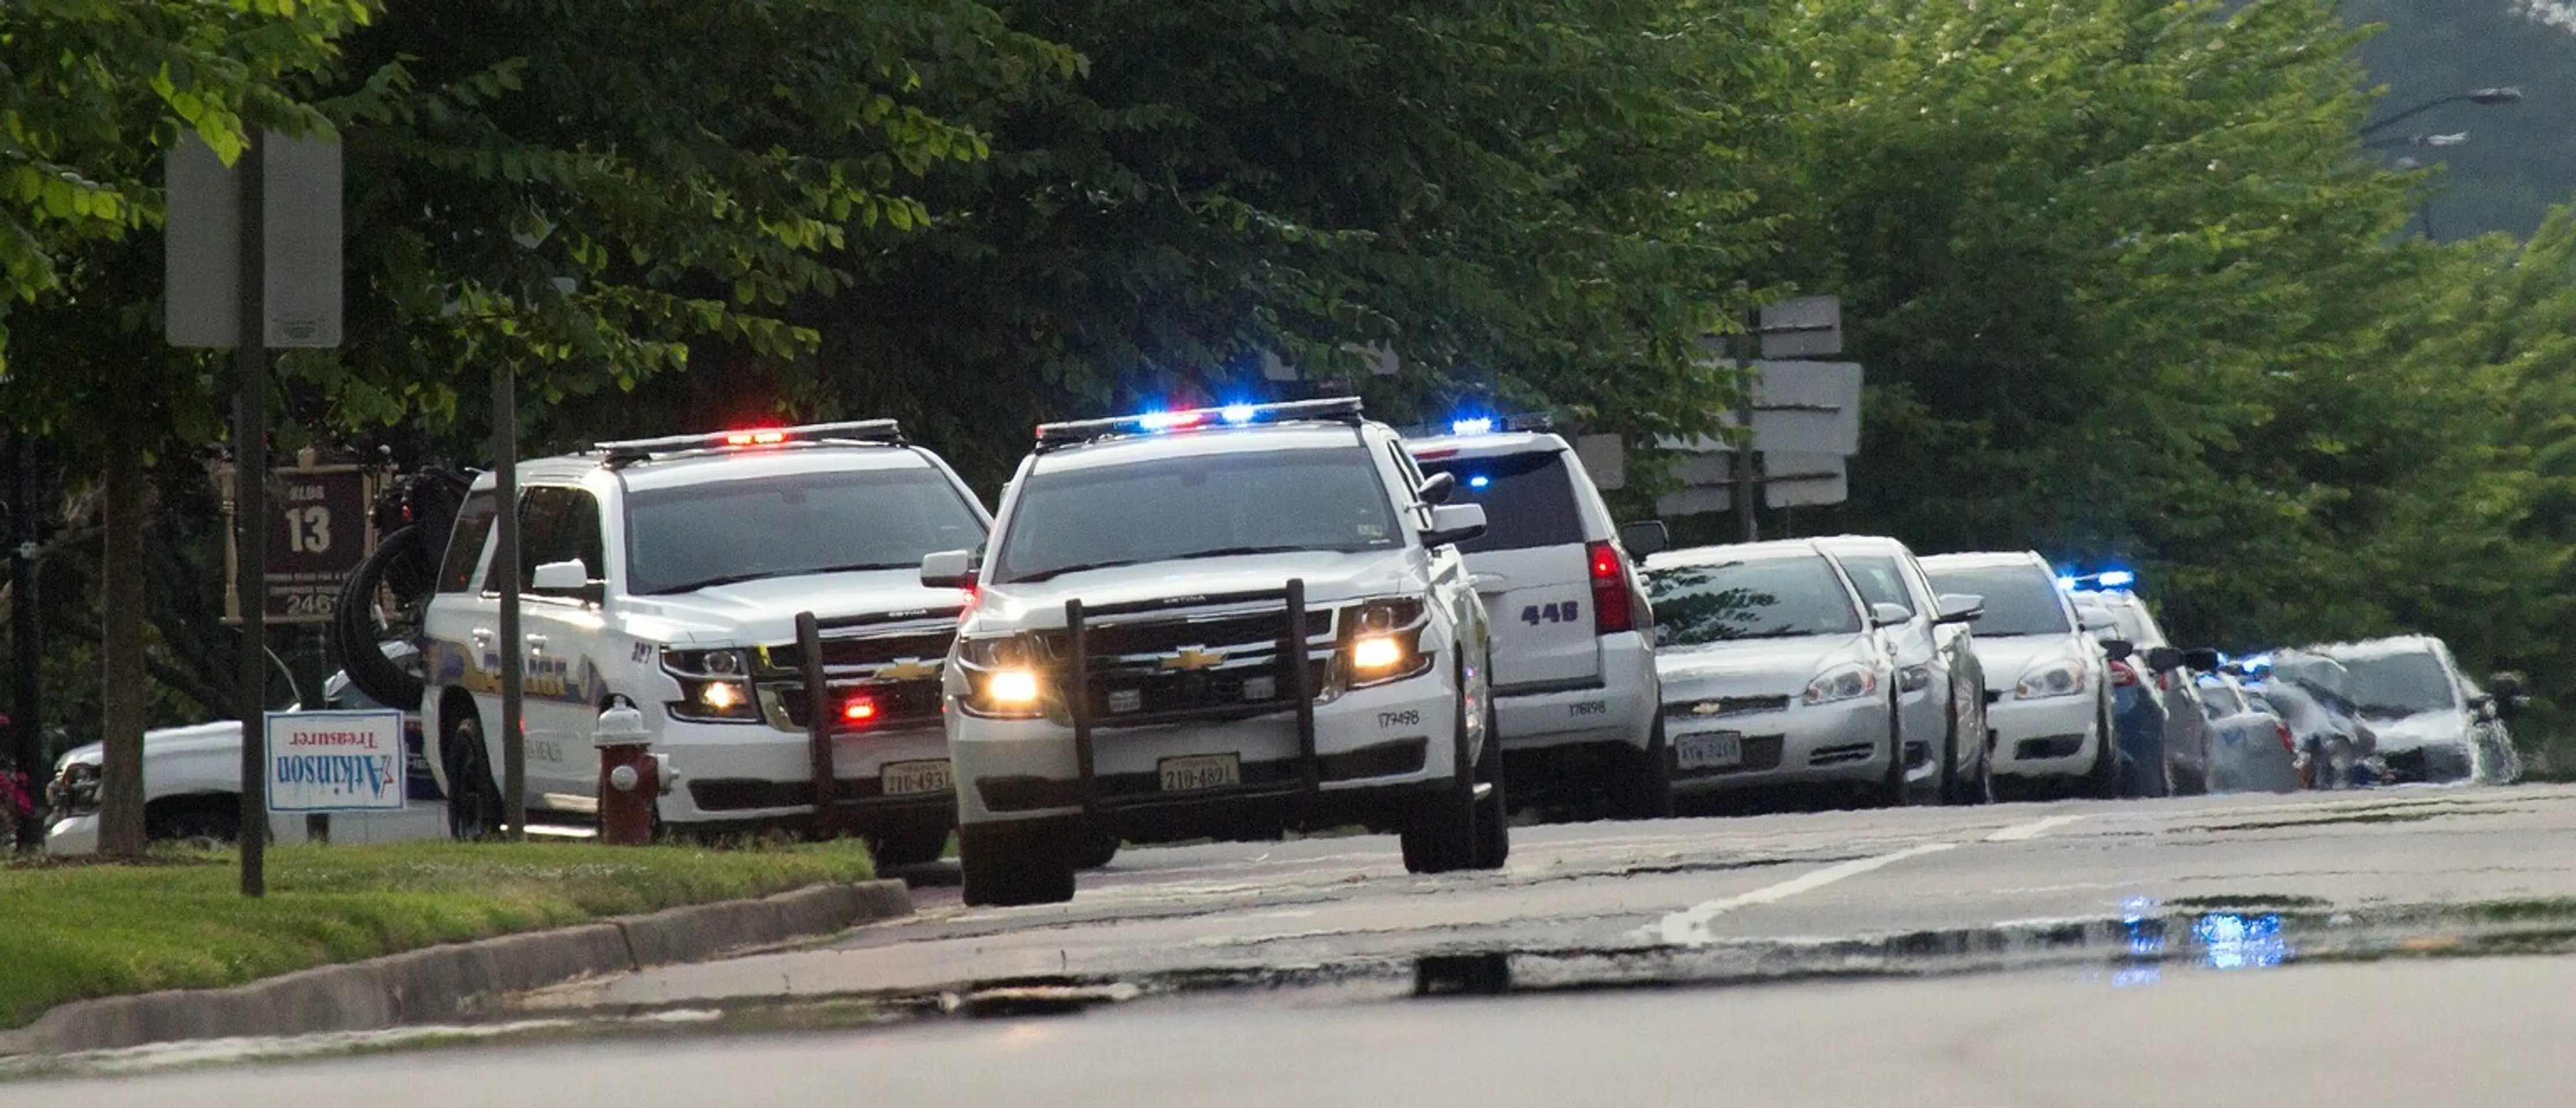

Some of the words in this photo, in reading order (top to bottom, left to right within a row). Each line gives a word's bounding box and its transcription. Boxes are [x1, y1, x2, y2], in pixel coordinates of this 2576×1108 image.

[285, 506, 330, 553] 13
[289, 731, 378, 748] Treasurer
[277, 754, 391, 800] Atkinson
